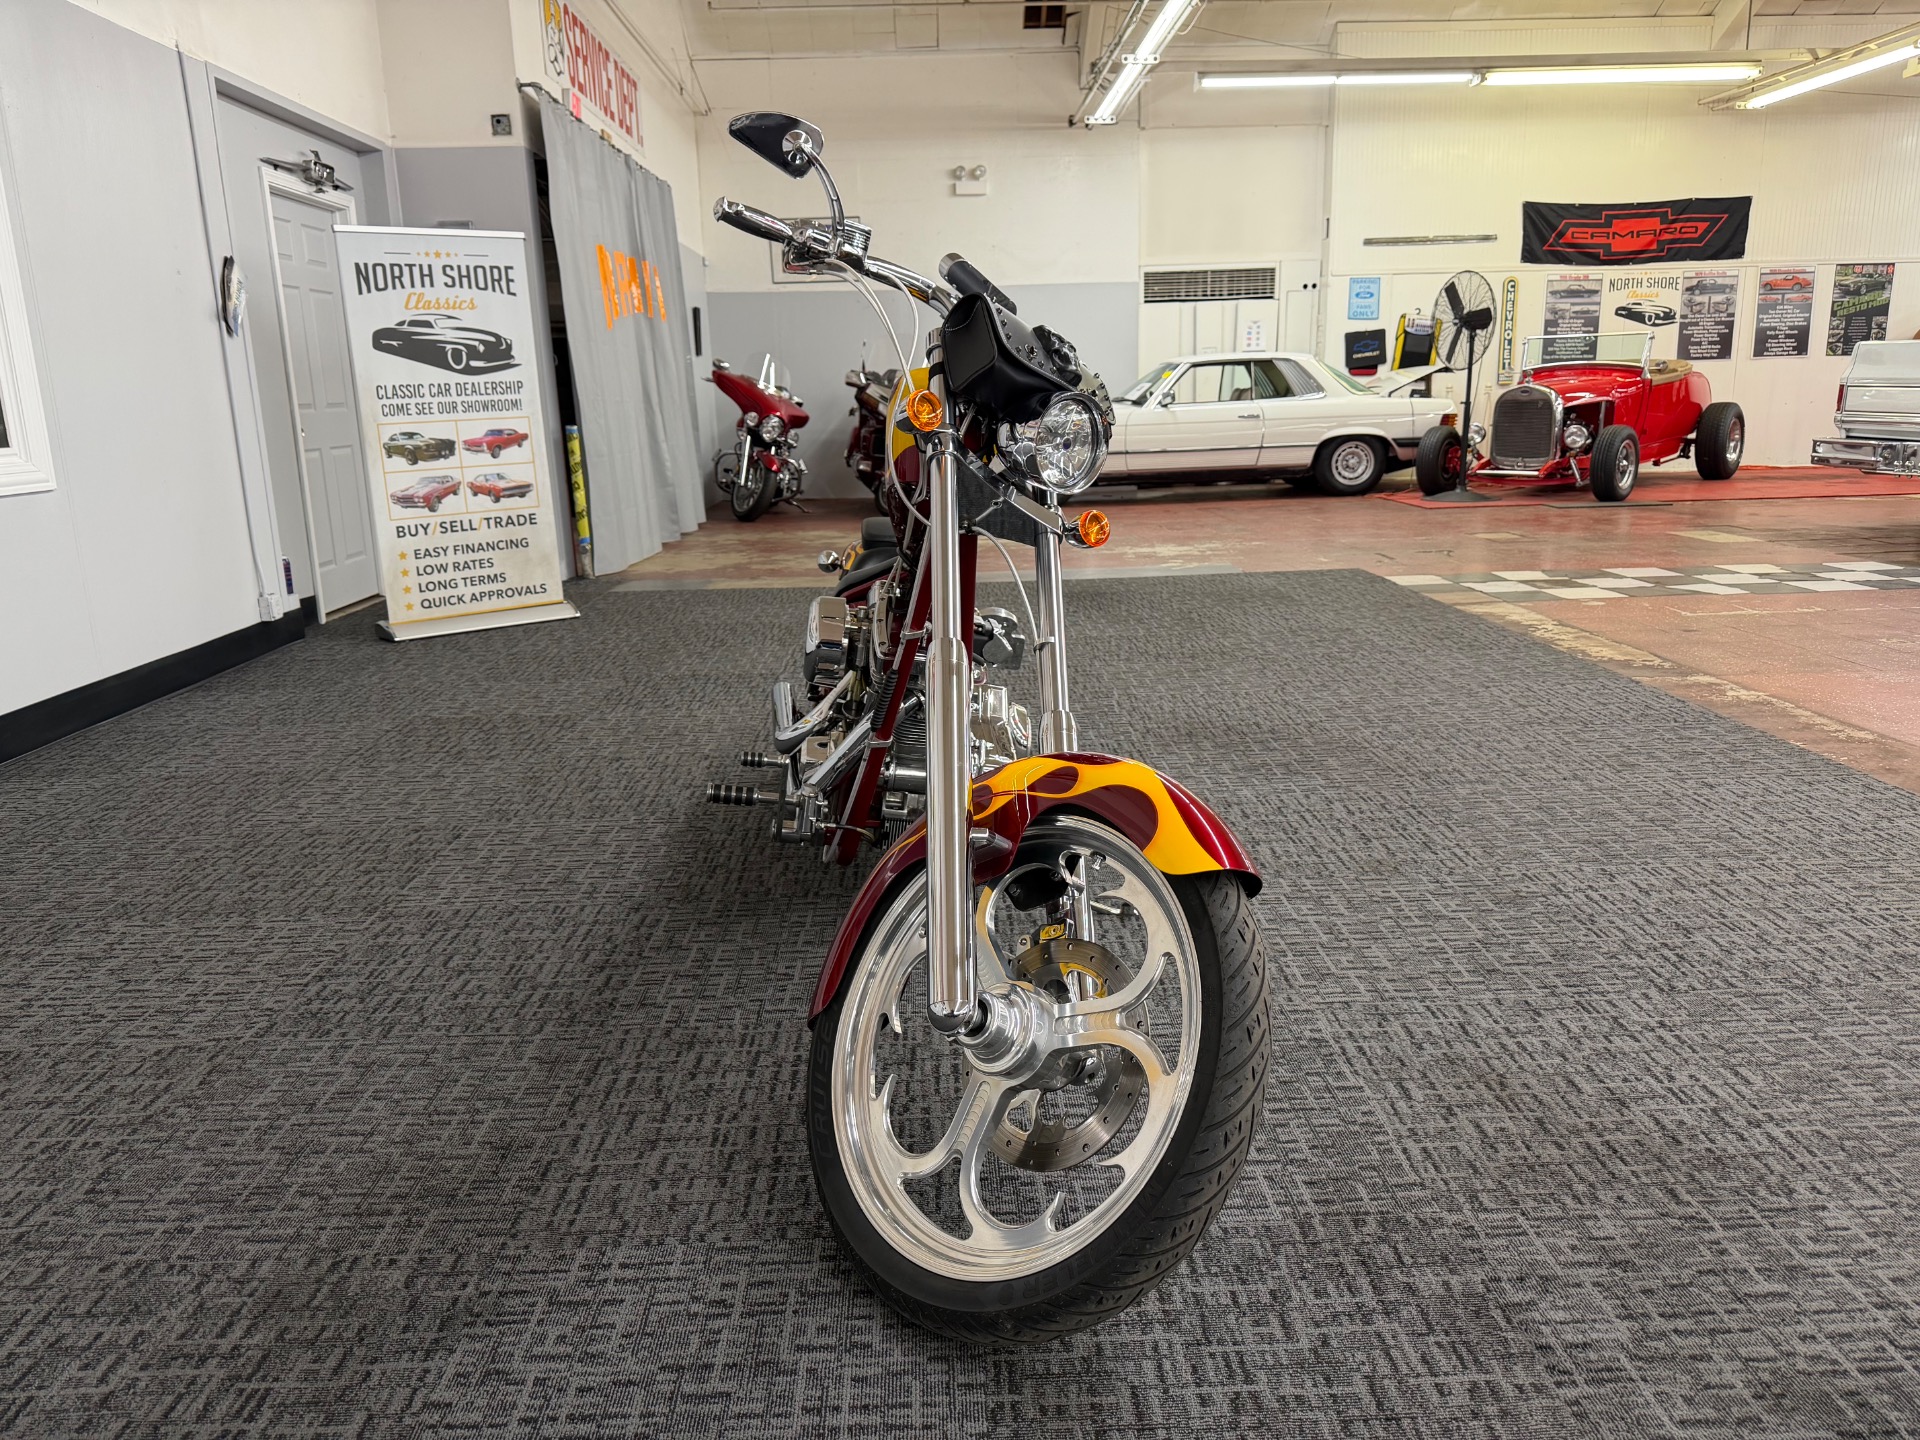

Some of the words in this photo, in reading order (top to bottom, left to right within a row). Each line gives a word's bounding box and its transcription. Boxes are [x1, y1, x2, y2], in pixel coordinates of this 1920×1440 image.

[563, 3, 615, 122] SERVICE
[1571, 225, 1698, 240] CAMARO
[354, 262, 435, 295] NORTH
[442, 264, 517, 297] SHORE
[1609, 278, 1643, 293] NORTH
[1646, 277, 1680, 291] SHORE
[404, 292, 478, 310] Classics
[1627, 290, 1659, 298] Classics
[1503, 281, 1515, 369] CHEVROLET
[1353, 350, 1380, 358] CHEVROLET
[376, 383, 425, 400] CLASSIC
[428, 382, 452, 398] CAR
[455, 380, 523, 397] DEALERSHIP
[381, 403, 412, 417] COME
[414, 402, 434, 416] SEE
[437, 401, 459, 414] OUR
[461, 398, 523, 413] SHOWROOM!
[414, 546, 449, 560] EASY
[453, 537, 529, 555] FINANCING
[416, 563, 448, 576] LOW
[452, 557, 494, 572] RATES
[418, 578, 458, 593] LONG
[461, 572, 507, 588] TERMS
[420, 593, 466, 609] QUICK
[469, 583, 547, 603] APPROVALS
